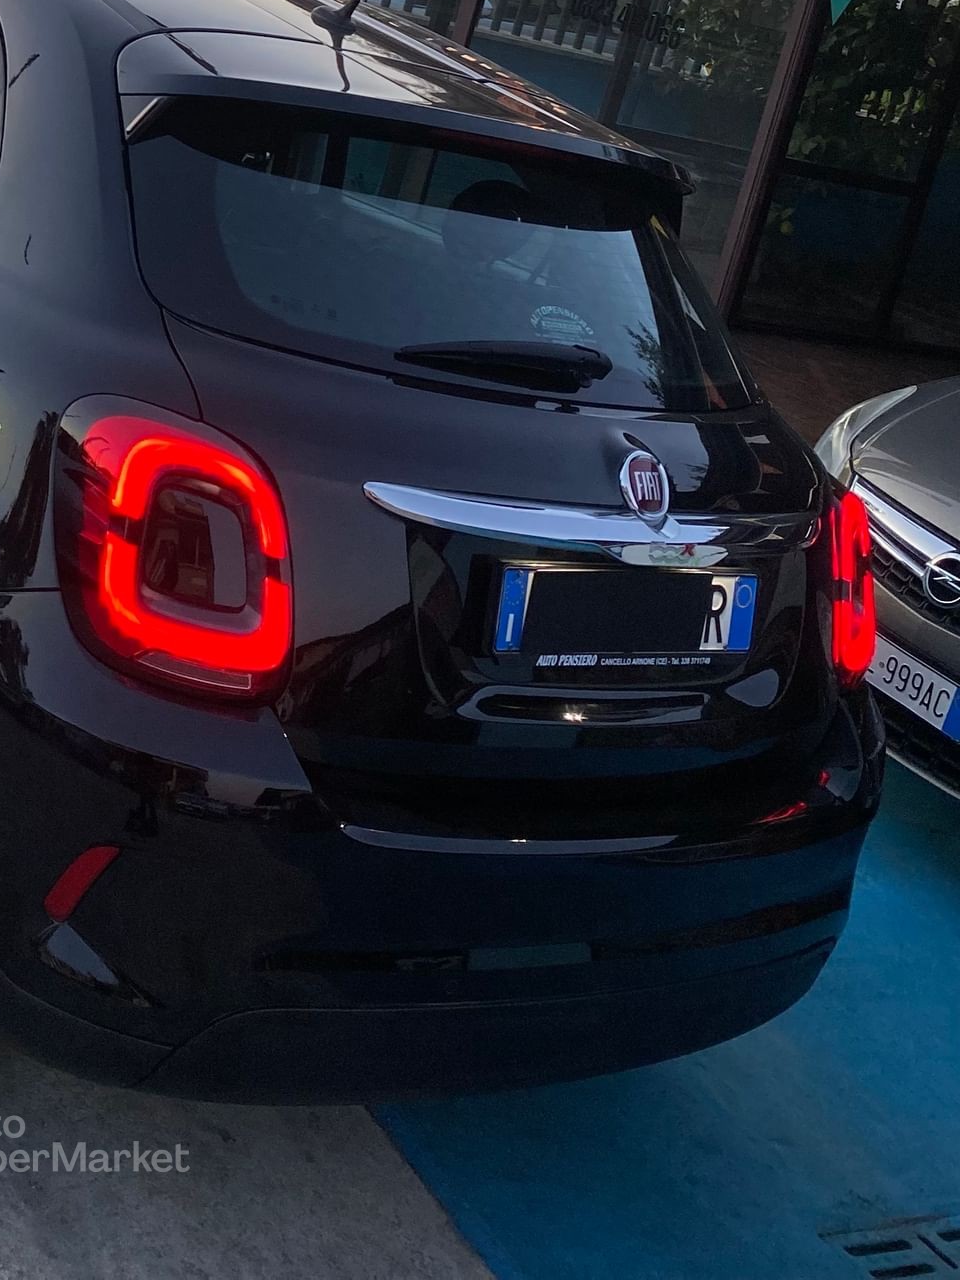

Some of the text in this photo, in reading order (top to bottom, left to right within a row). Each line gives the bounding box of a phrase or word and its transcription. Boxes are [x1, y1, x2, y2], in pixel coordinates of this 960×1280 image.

[634, 471, 661, 501] FIAT
[536, 654, 557, 666] AUTO
[558, 654, 598, 666] PENSIERO
[601, 657, 631, 666] CANCELLO
[883, 656, 951, 718] 999AC
